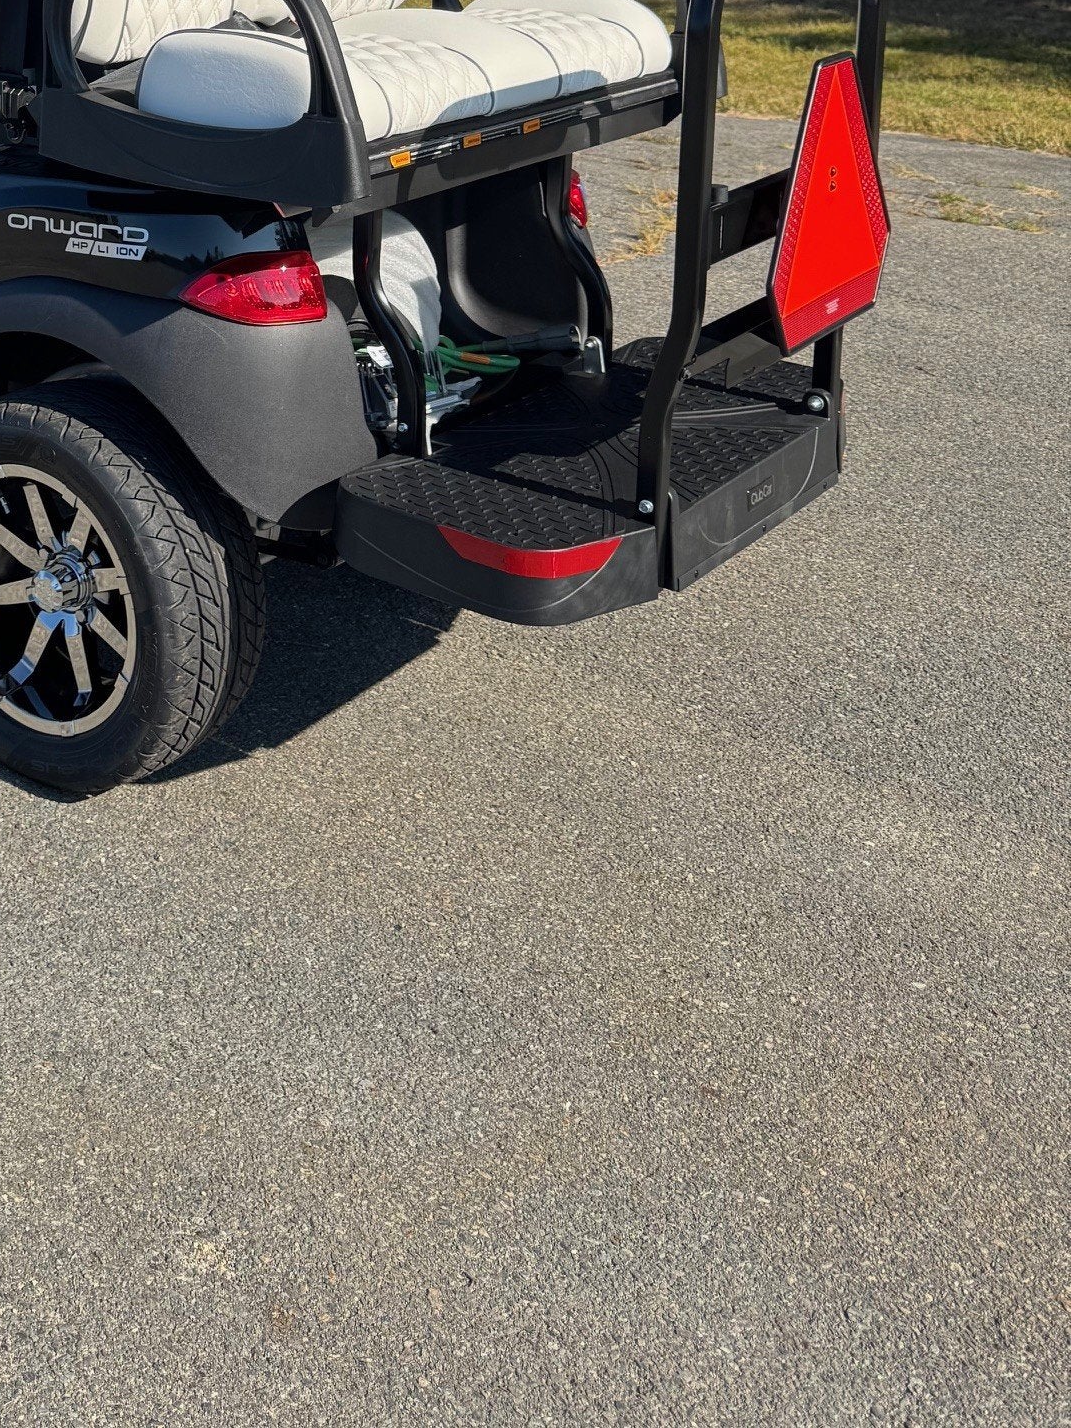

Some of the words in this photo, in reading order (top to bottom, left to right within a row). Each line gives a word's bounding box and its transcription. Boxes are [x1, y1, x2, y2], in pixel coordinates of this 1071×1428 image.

[72, 240, 88, 250] HP
[97, 244, 109, 254] LI
[115, 246, 139, 257] ION
